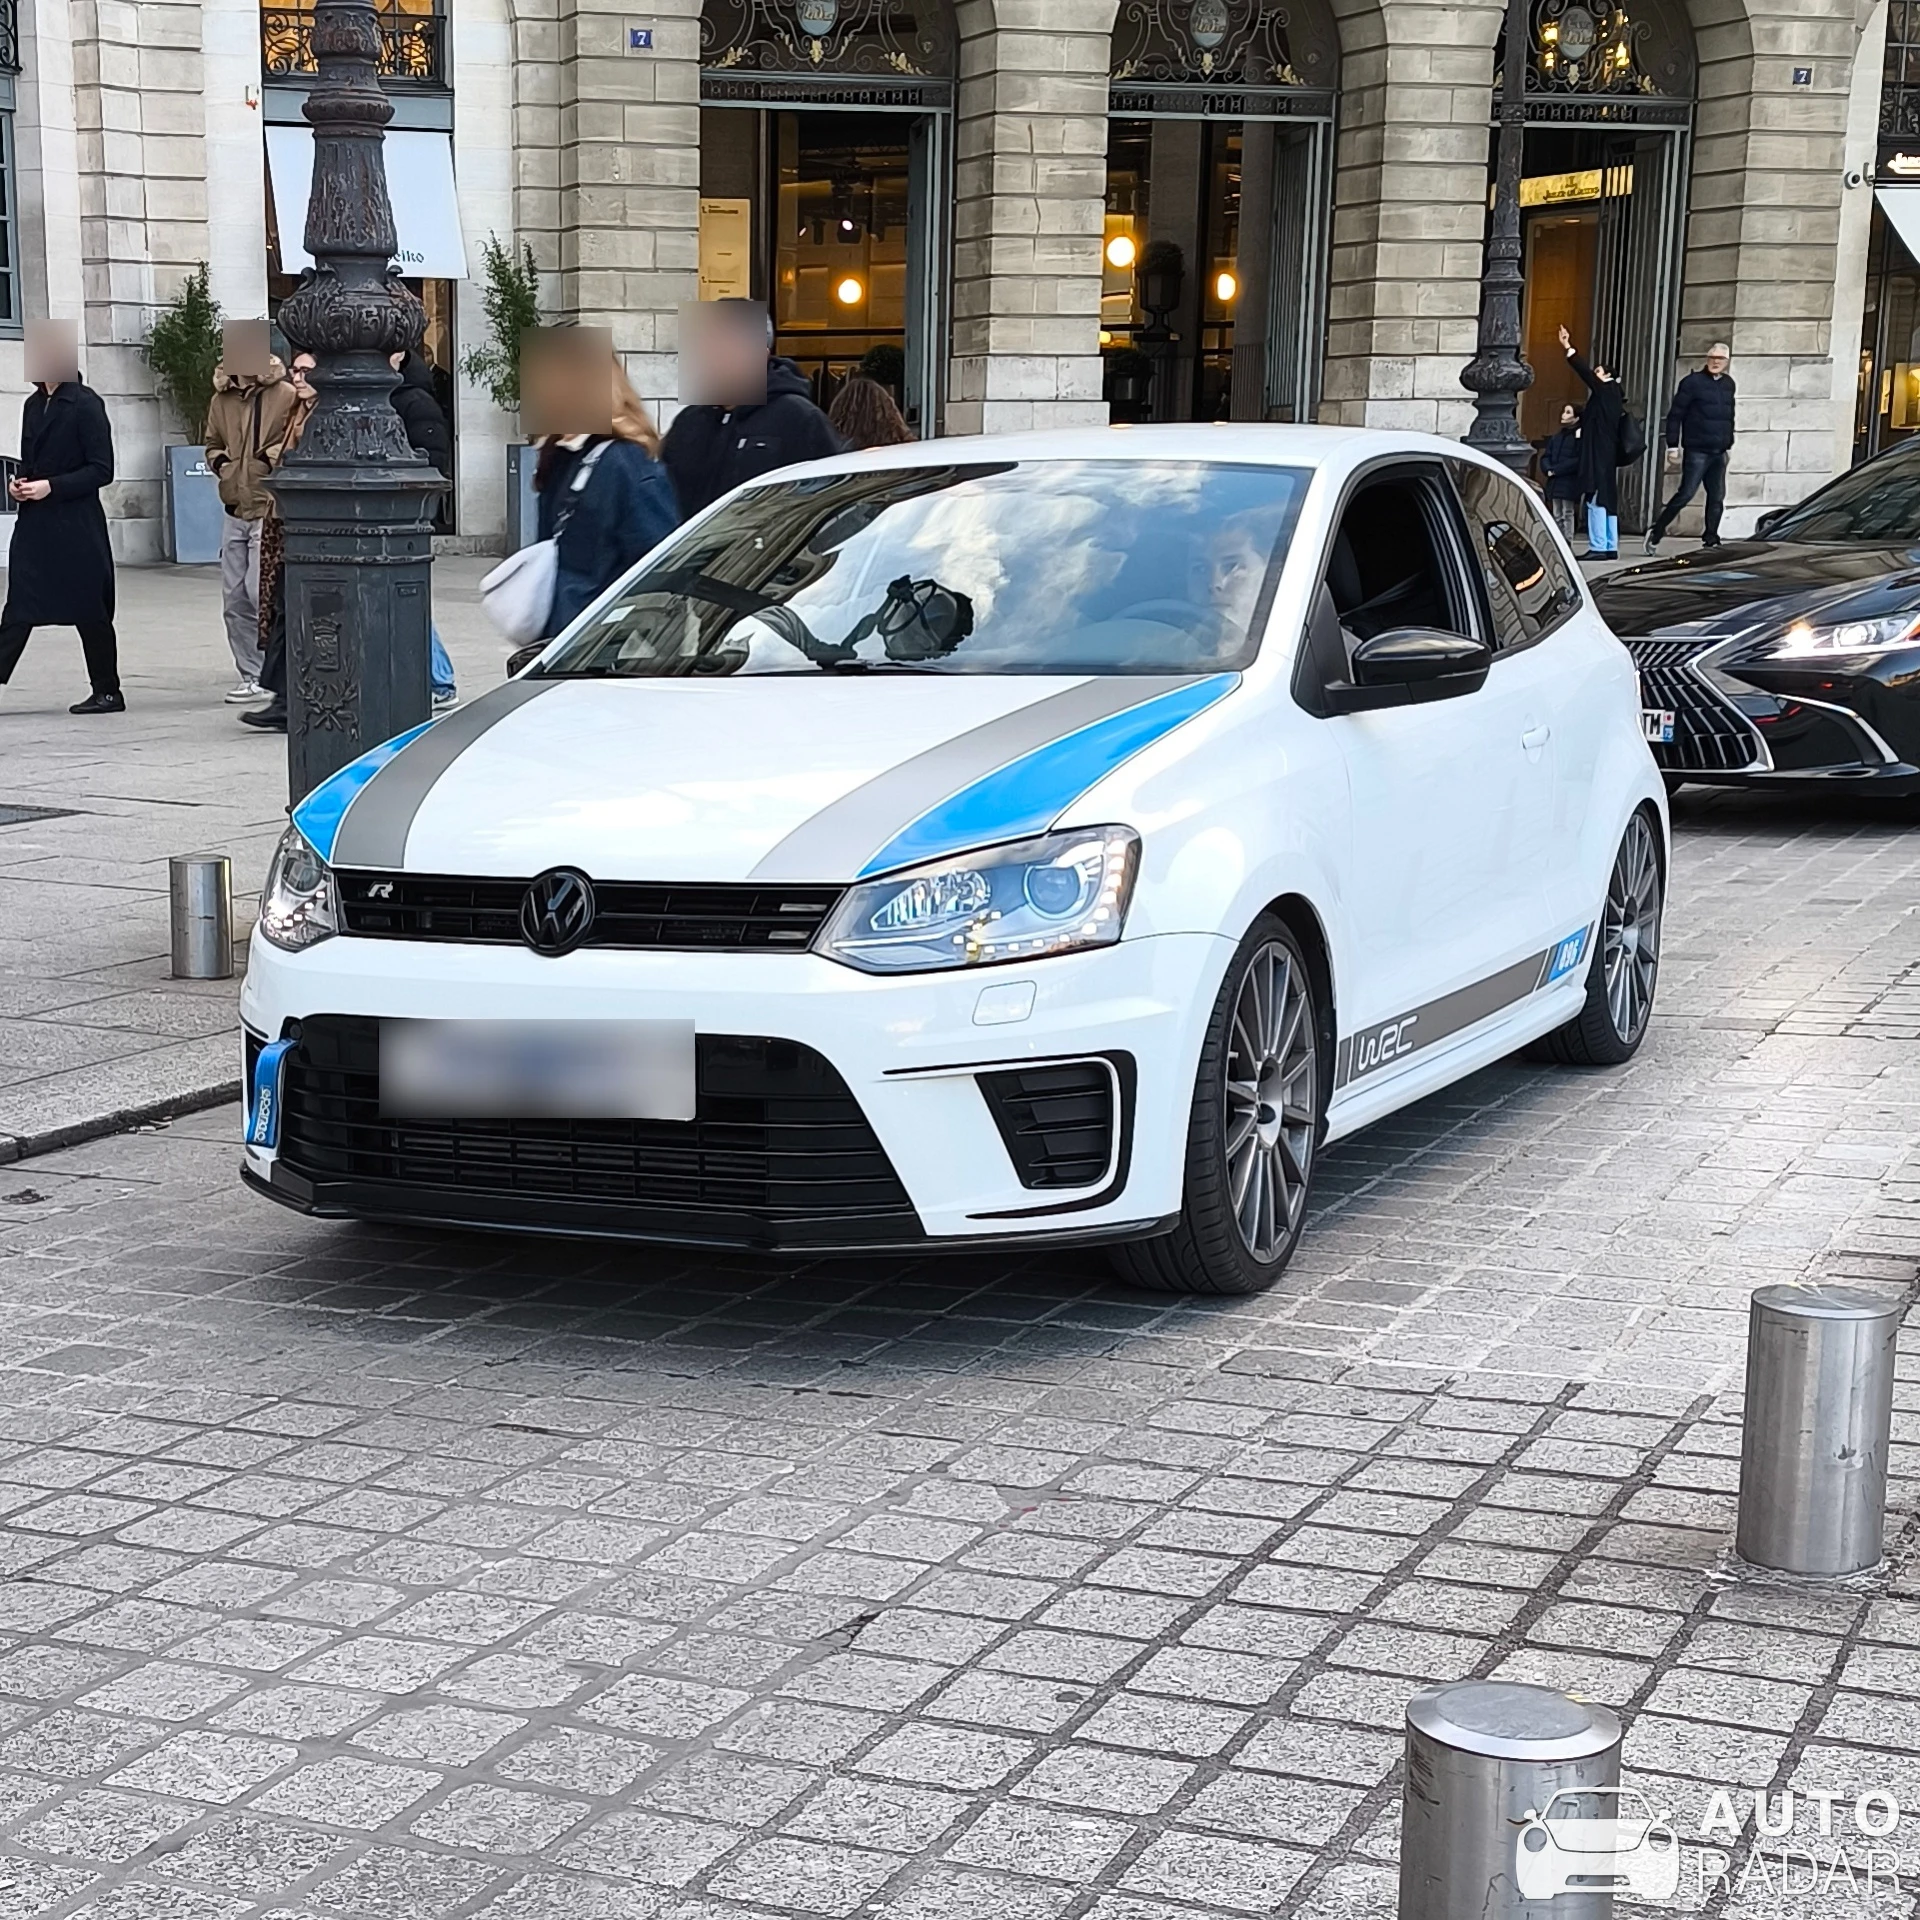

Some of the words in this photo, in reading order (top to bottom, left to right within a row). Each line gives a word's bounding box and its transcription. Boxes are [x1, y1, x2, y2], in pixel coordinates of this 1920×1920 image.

[637, 31, 647, 46] 7
[1799, 70, 1808, 83] 7
[367, 881, 394, 899] R
[1358, 1015, 1418, 1072] WRC
